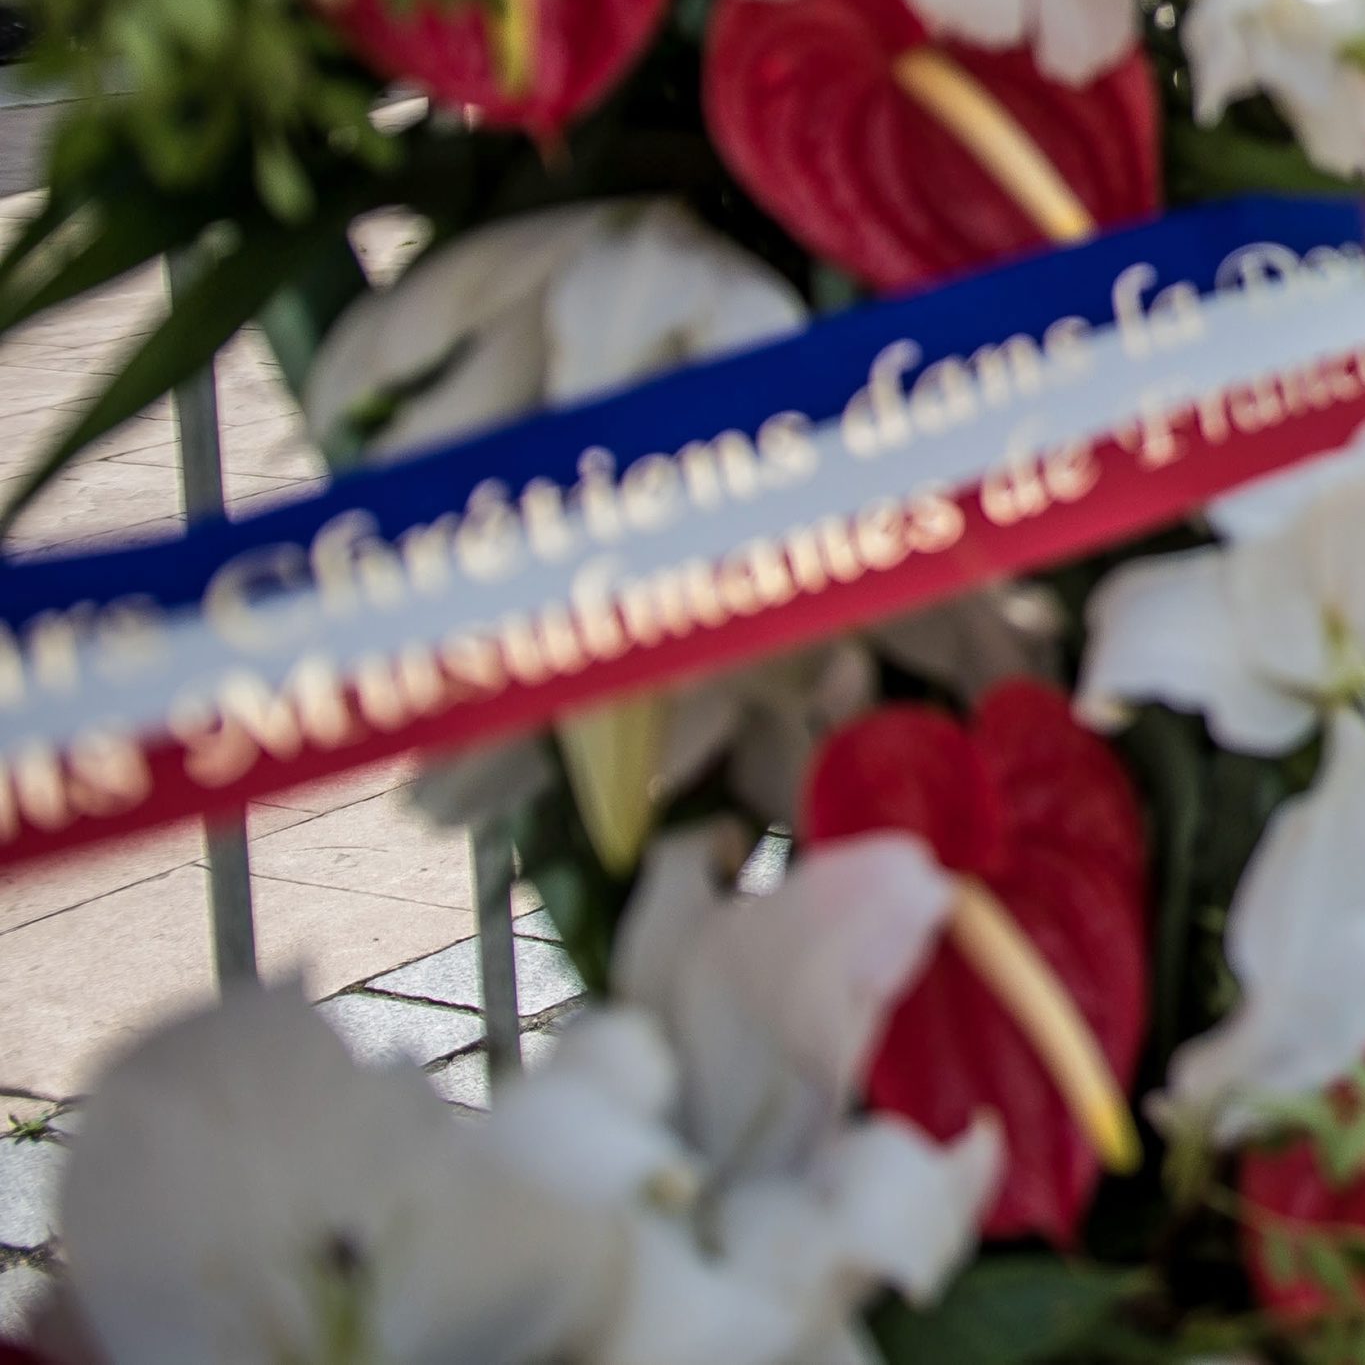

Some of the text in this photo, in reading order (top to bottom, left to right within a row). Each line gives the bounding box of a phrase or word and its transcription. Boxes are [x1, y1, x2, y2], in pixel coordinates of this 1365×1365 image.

[169, 486, 965, 788] Musulmanes
[979, 439, 1101, 528] de
[205, 411, 821, 654] Chrétiens
[842, 336, 1094, 459] dans
[1113, 262, 1201, 357] la
